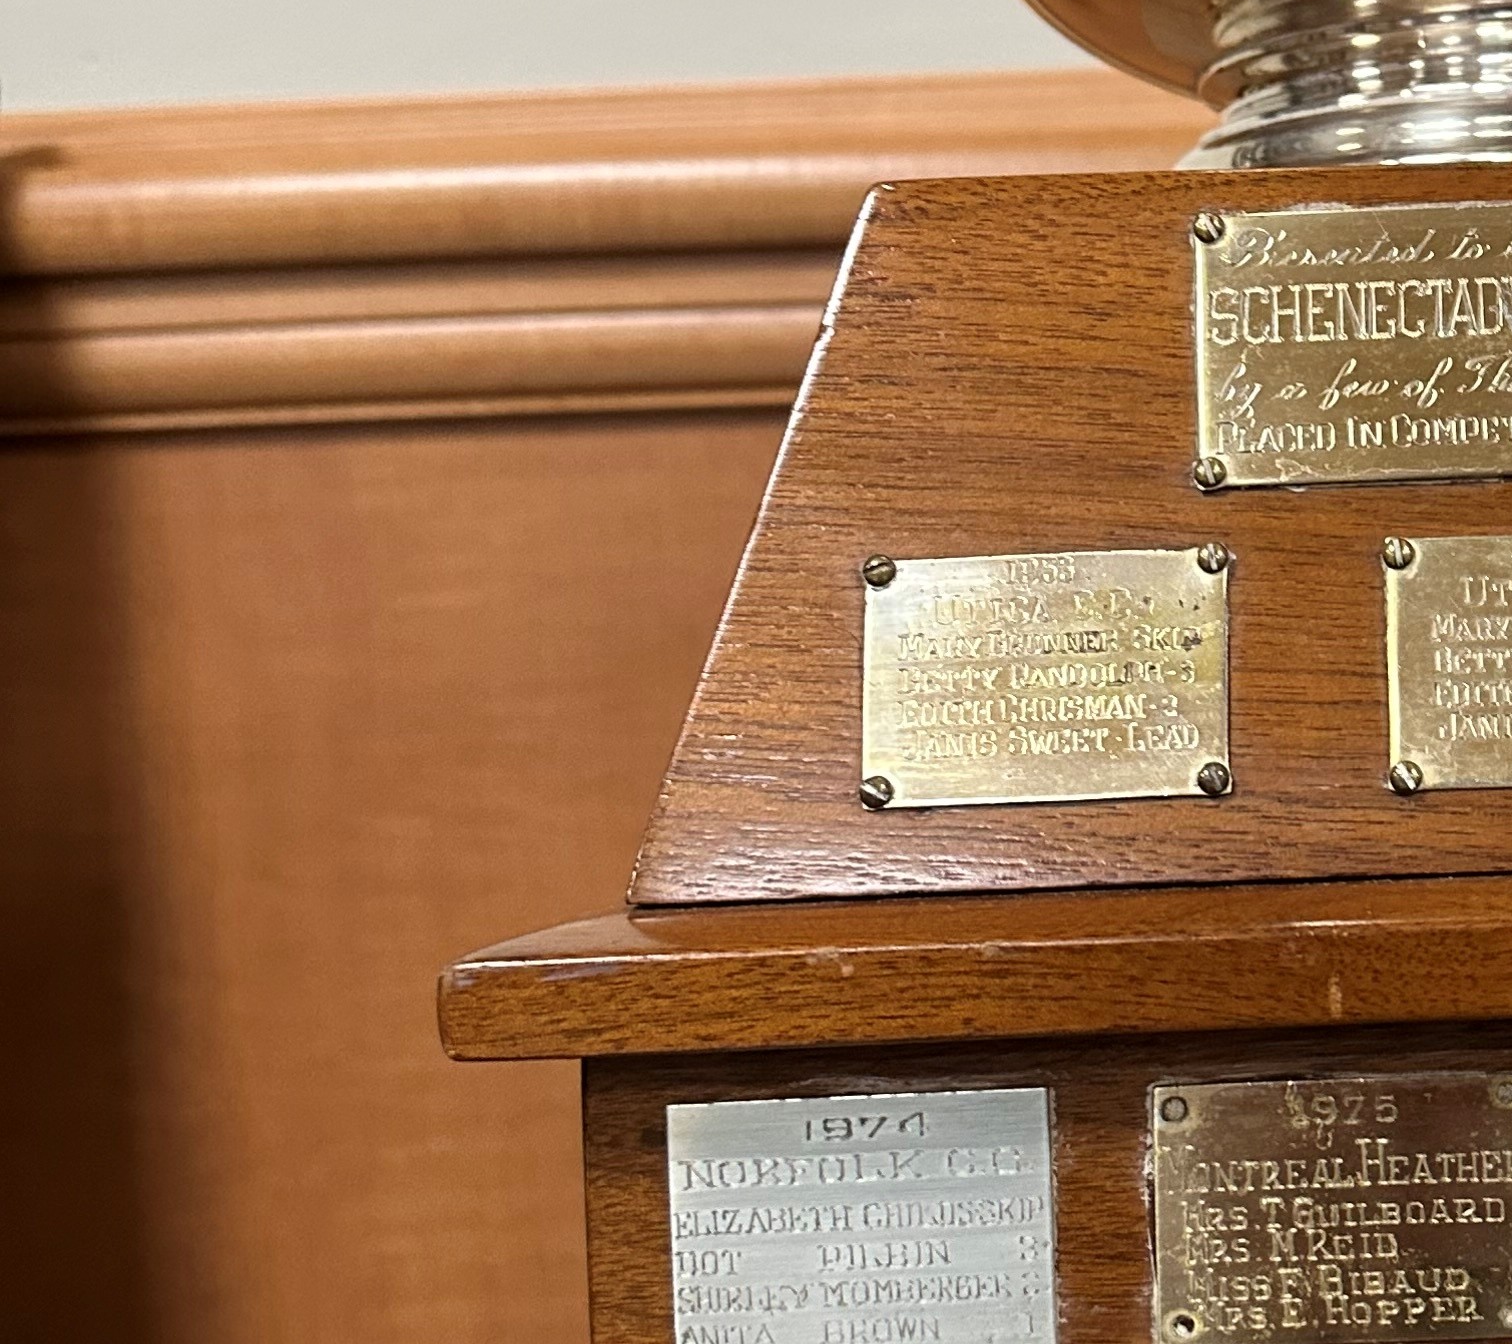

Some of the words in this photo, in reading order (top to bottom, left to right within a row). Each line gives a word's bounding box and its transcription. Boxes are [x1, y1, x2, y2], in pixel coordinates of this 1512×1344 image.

[1450, 228, 1490, 259] to
[1215, 362, 1263, 419] by
[1319, 358, 1398, 410] few
[1403, 356, 1444, 408] of
[1216, 419, 1336, 455] PLACED
[1348, 416, 1383, 450] IN
[804, 1111, 929, 1142] 1974
[678, 1151, 924, 1191] NORFOLK
[1159, 1145, 1354, 1194] MONTREAL
[675, 1203, 852, 1239] ELIZABETH
[1327, 1295, 1484, 1325] HOPPER
